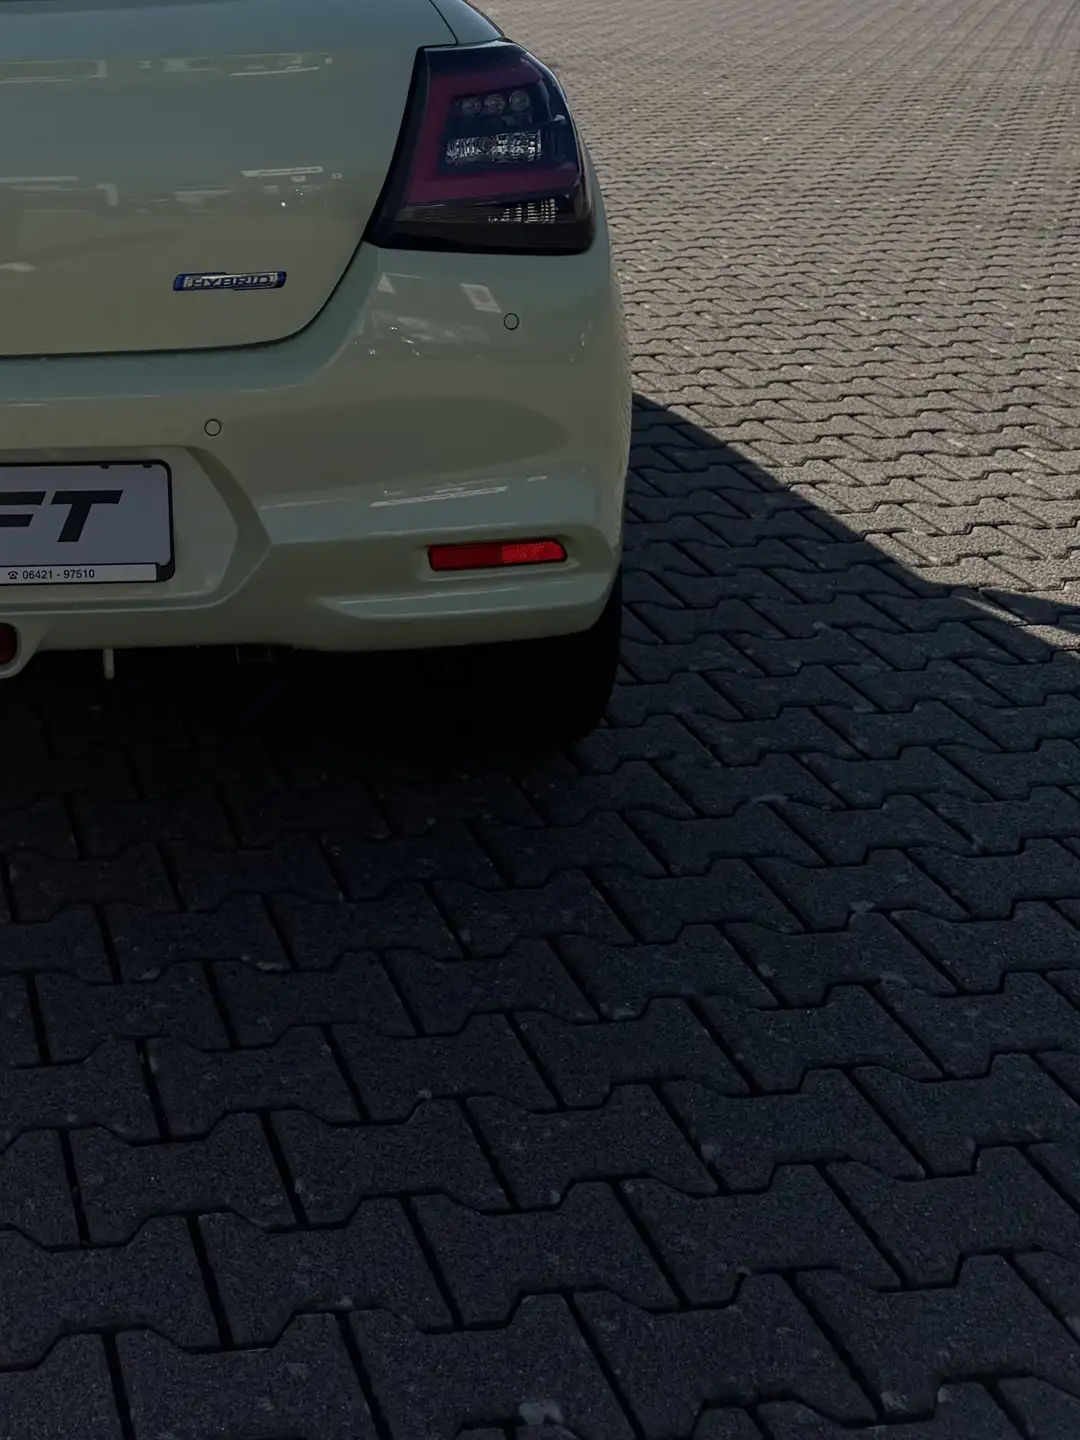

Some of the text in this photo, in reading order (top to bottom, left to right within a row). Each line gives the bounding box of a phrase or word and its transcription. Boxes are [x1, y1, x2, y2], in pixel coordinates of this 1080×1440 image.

[191, 274, 271, 288] HYBRID
[22, 569, 53, 580] 06421
[63, 569, 95, 579] 97510
